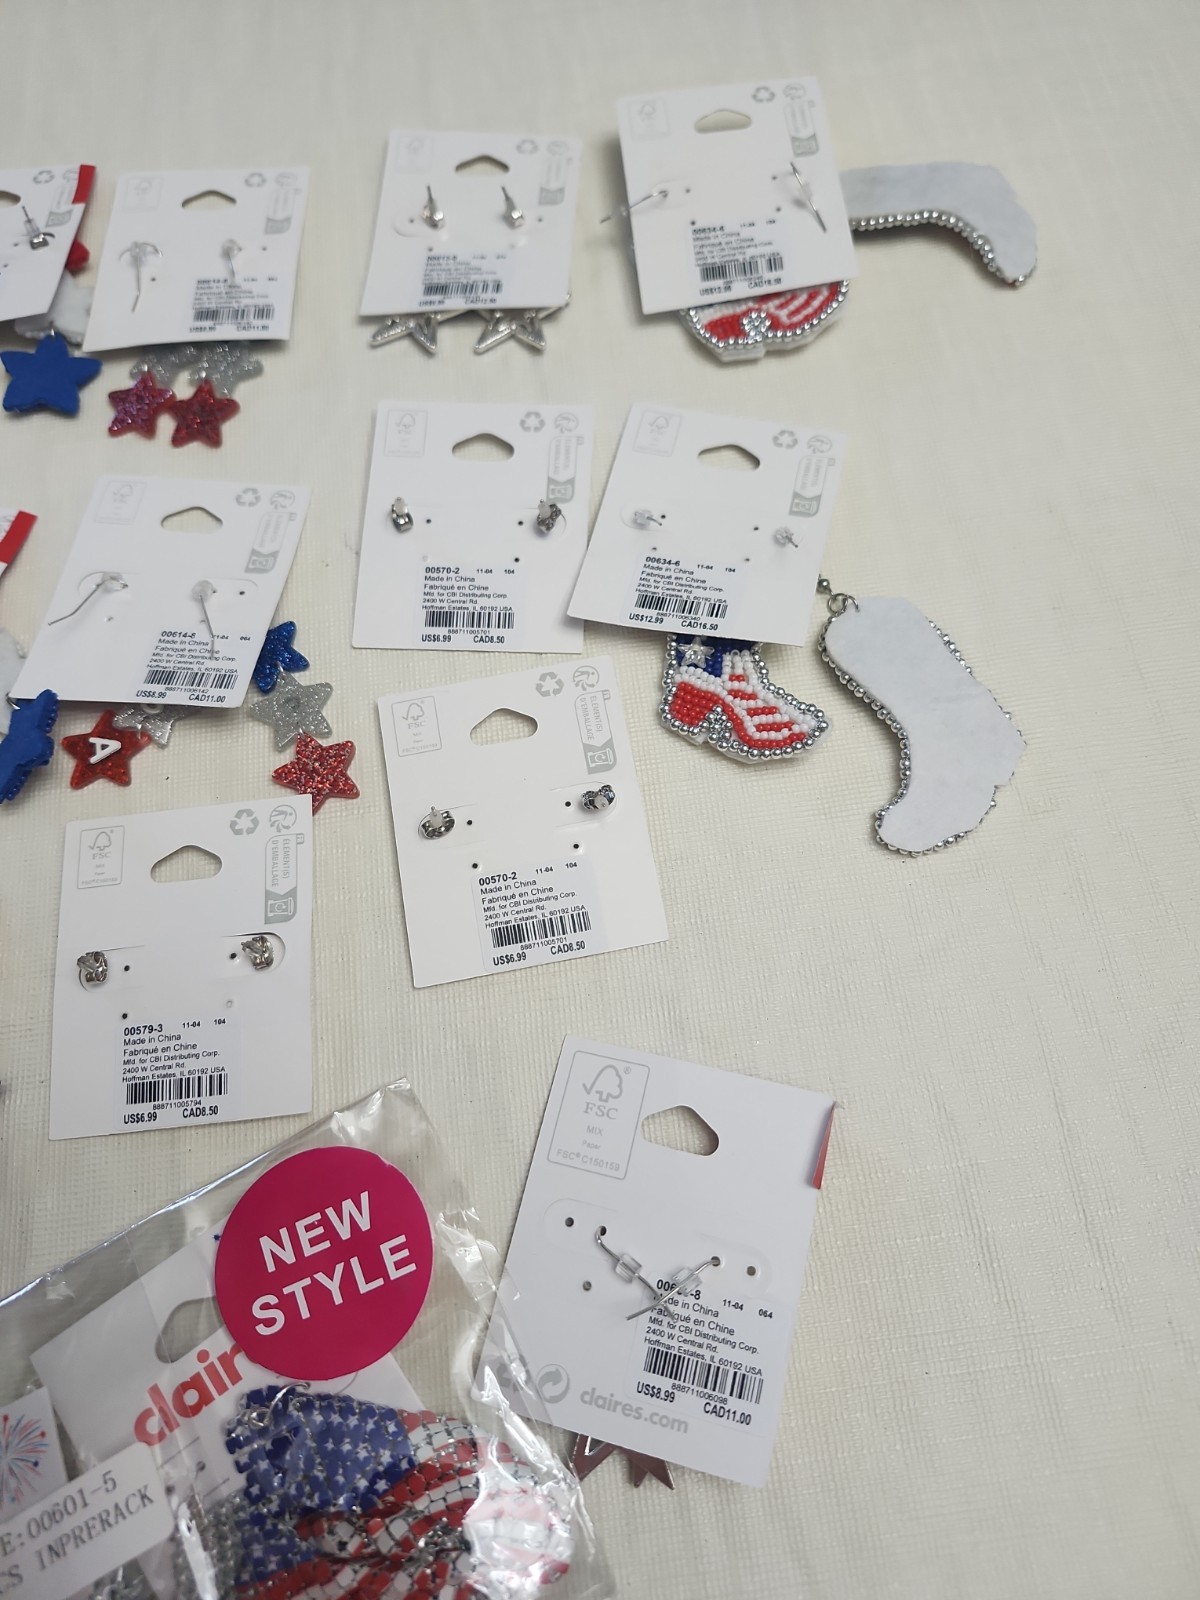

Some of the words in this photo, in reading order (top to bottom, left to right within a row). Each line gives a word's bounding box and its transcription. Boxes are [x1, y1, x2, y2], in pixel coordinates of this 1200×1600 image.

[646, 556, 680, 566] 00634-6
[641, 571, 672, 580] Fabriqué
[685, 576, 706, 584] Chine
[674, 567, 694, 575] China
[629, 613, 664, 624] US$12.99
[681, 621, 718, 631] CAD16.50
[421, 634, 451, 642] US$6.99
[473, 635, 504, 643] CAD8.50
[135, 690, 167, 699] US$8.99
[189, 694, 226, 702] CAD11.00
[88, 737, 122, 764] A
[479, 871, 517, 886] 00570-2
[536, 866, 553, 874] 11-04
[480, 886, 502, 895] Made
[514, 880, 537, 889] China
[482, 893, 516, 904] Fabriqué
[531, 886, 553, 896] Chine
[523, 895, 558, 906] Distributing
[485, 919, 512, 928] Hoffman
[549, 907, 569, 916] 60192
[511, 906, 533, 915] Central
[521, 937, 567, 951] 888711005701
[493, 952, 527, 966] US$6.99
[551, 940, 585, 955] CAD8.50
[124, 1024, 163, 1036] 00579-3
[124, 1037, 146, 1046] Made
[158, 1034, 181, 1042] China
[124, 1046, 158, 1056] Fabriqué
[174, 1043, 197, 1052] Chine
[164, 1052, 200, 1061] Distributing
[150, 1063, 173, 1071] Central
[188, 1068, 208, 1076] 60192
[153, 1100, 202, 1110] 888711005794
[584, 1102, 618, 1119] FSC
[124, 1111, 157, 1124] US$6.99
[183, 1105, 218, 1118] CAD8.50
[586, 1125, 603, 1136] MIX
[582, 1140, 601, 1150] Paper
[259, 1191, 372, 1273] NEW
[251, 1234, 417, 1336] STYLE
[653, 1293, 679, 1306] de
[681, 1300, 689, 1309] in
[692, 1303, 719, 1318] China
[656, 1280, 701, 1300] 006-8
[723, 1299, 744, 1311] 11-04
[758, 1309, 773, 1318] 064
[649, 1316, 664, 1327] Mfd.
[667, 1322, 676, 1330] for
[678, 1326, 692, 1334] CBI
[694, 1330, 737, 1349] Distributing
[738, 1342, 759, 1354] Corp.
[693, 1319, 705, 1327] en
[708, 1321, 735, 1335] Chine
[646, 1326, 665, 1337] 2400
[677, 1336, 704, 1348] Central
[706, 1344, 719, 1353] Rd.
[644, 1336, 676, 1351] Hoffman
[678, 1346, 707, 1361] Estates,
[718, 1358, 742, 1370] 60192
[745, 1364, 763, 1376] USA
[672, 1383, 728, 1405] 888711006098
[580, 1387, 689, 1434] claires.com
[636, 1381, 676, 1403] US$8.99
[703, 1401, 751, 1425] CAD11.00
[35, 1484, 155, 1571] INPRERACK
